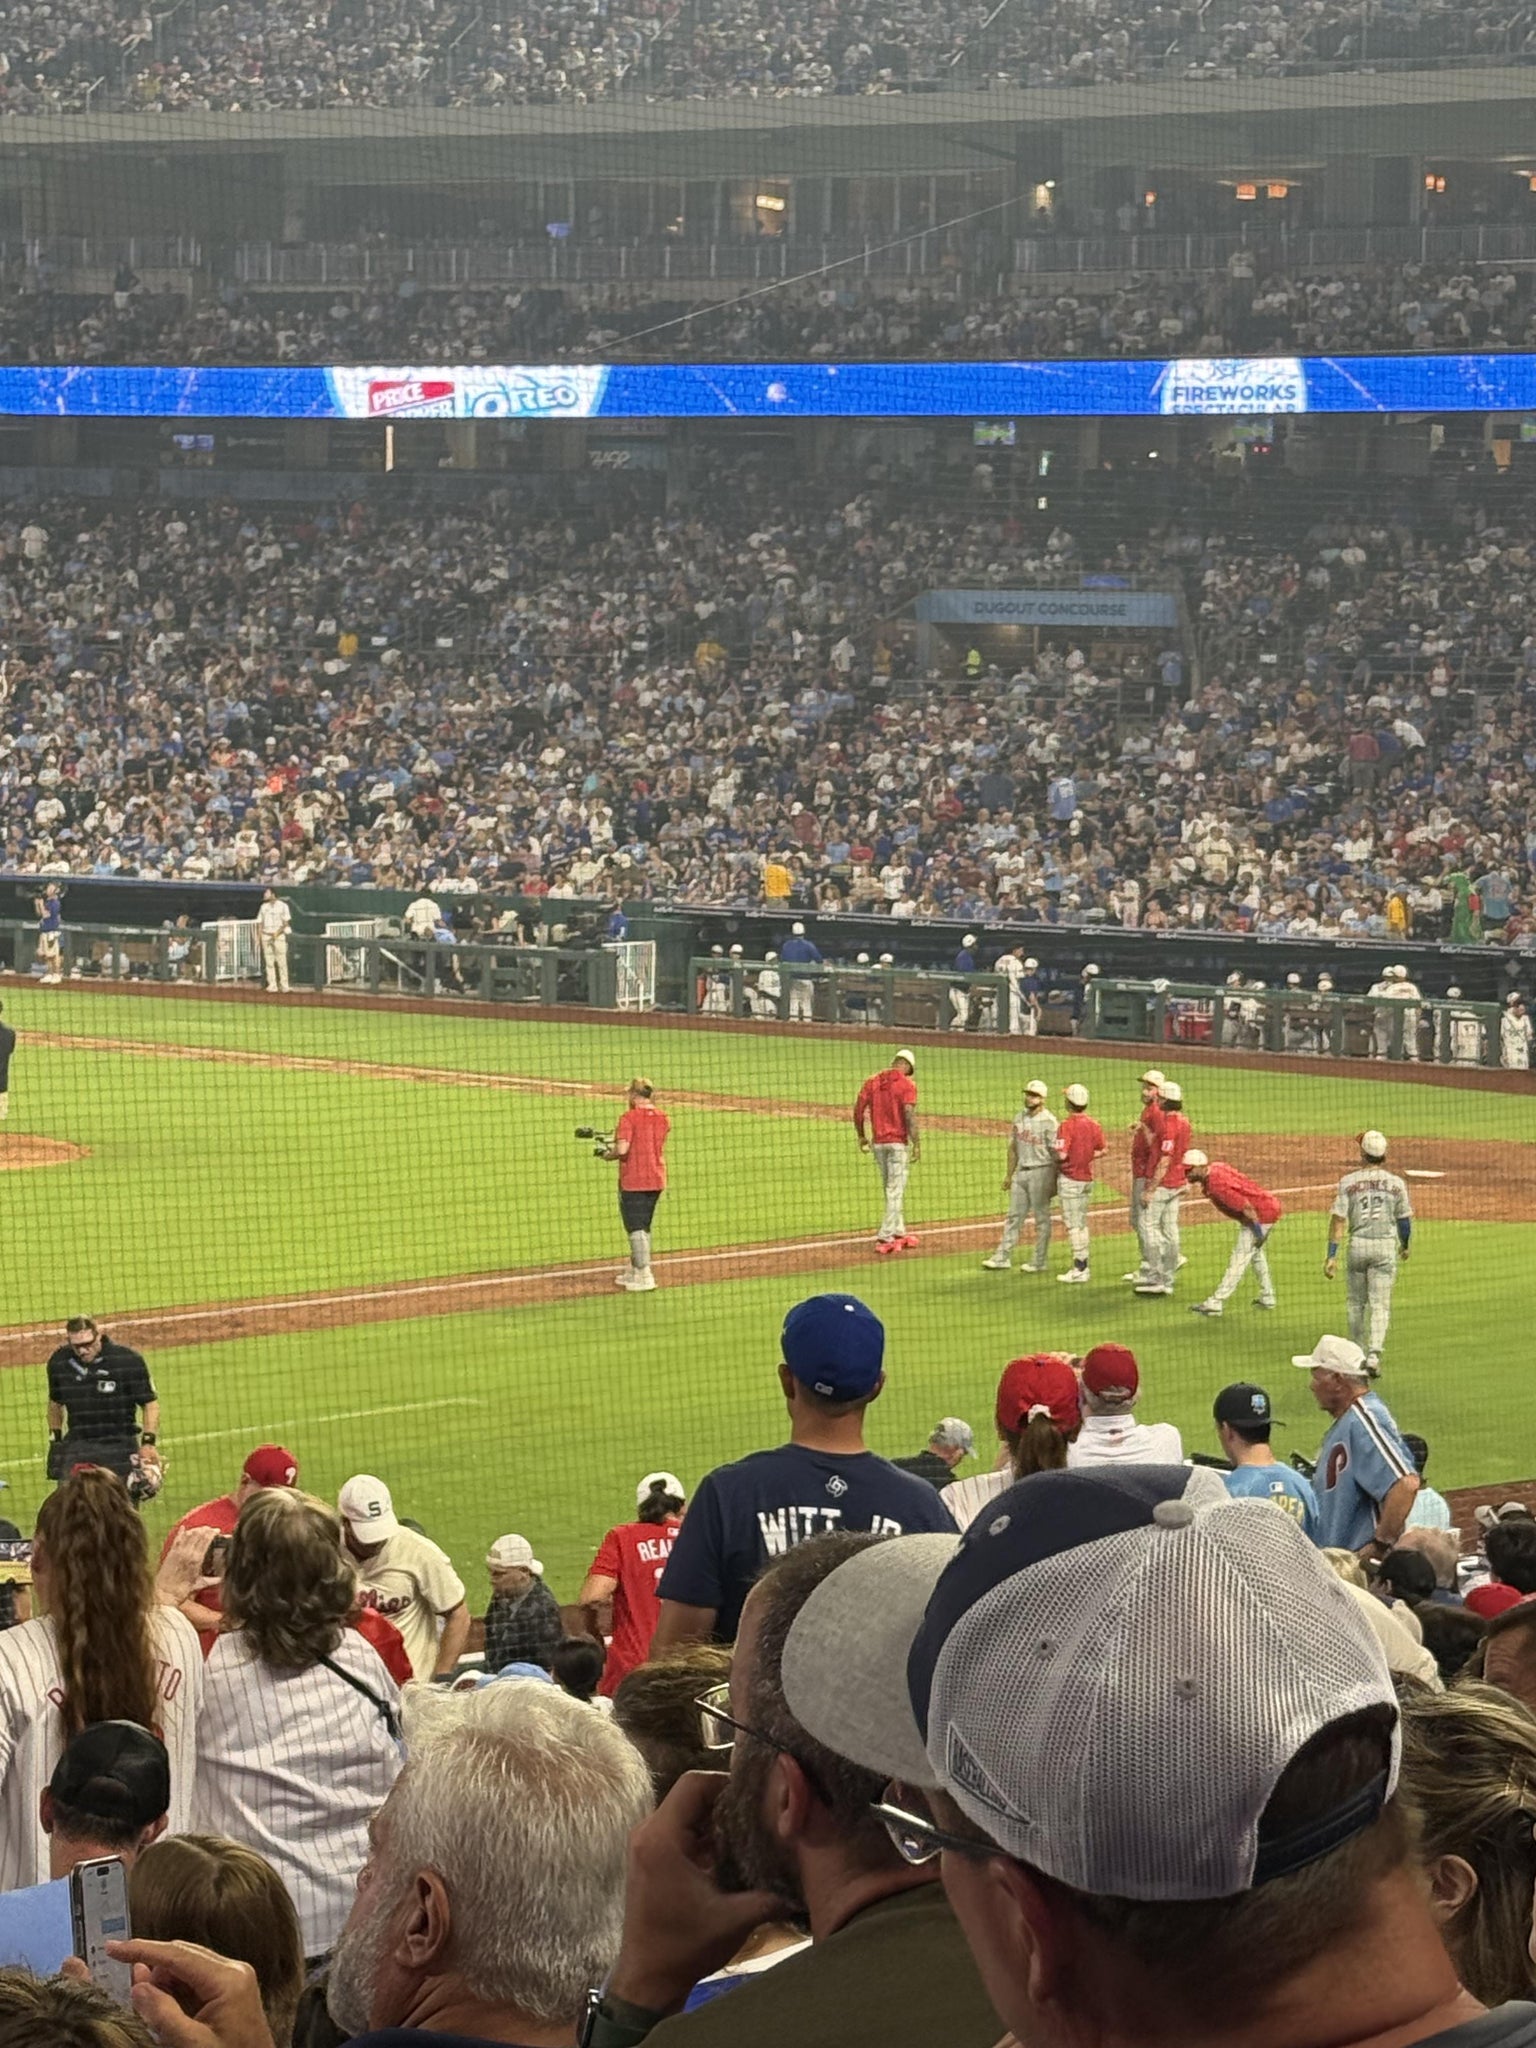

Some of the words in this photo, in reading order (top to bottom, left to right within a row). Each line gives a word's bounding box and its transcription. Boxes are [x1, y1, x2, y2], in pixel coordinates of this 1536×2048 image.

[372, 383, 425, 411] PRICE
[473, 385, 579, 417] OREO
[1173, 384, 1297, 402] FIREWORKS
[974, 602, 1036, 615] DUGOUT
[1038, 602, 1127, 617] CONCOURSE
[285, 1467, 296, 1485] P
[1325, 1441, 1349, 1493] P
[368, 1501, 382, 1517] S
[756, 1506, 842, 1557] WITT
